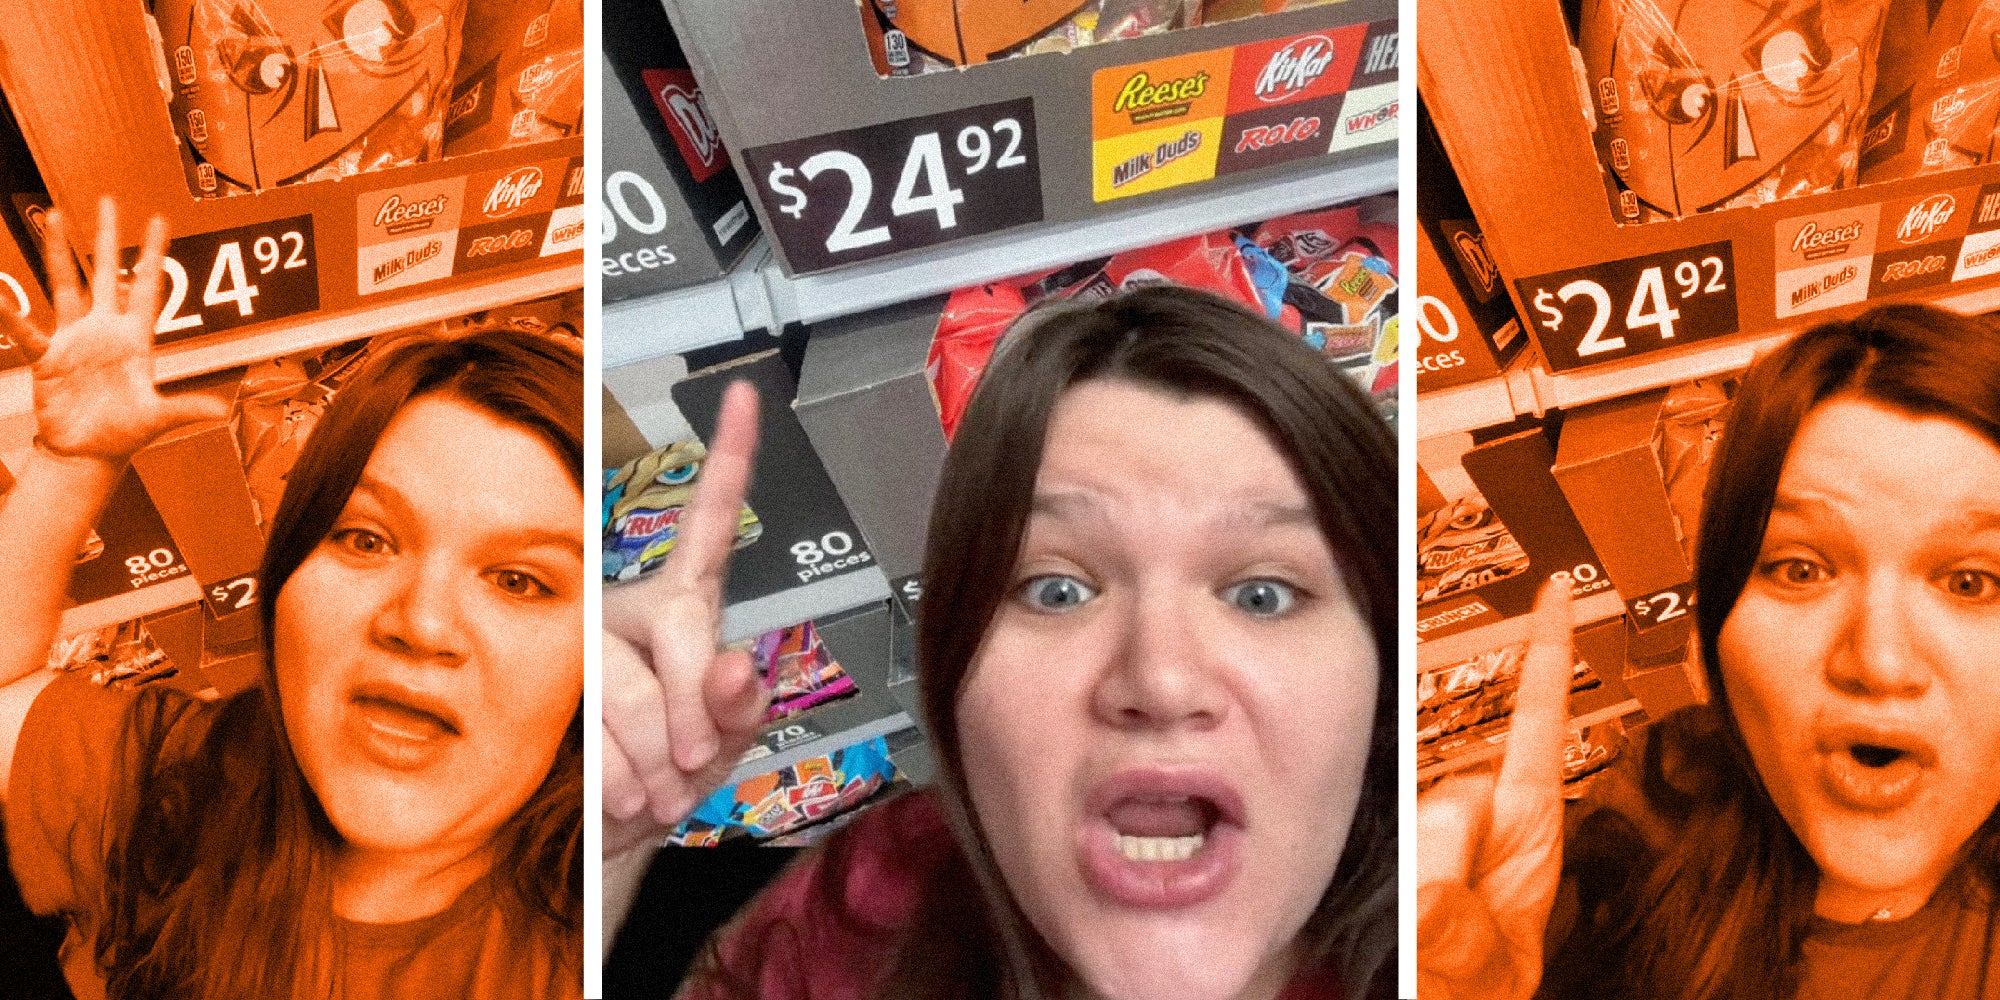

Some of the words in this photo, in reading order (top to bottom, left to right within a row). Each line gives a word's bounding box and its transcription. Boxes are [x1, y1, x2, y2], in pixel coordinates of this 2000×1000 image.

[887, 34, 904, 50] 130
[1255, 42, 1334, 95] KitKat
[1114, 71, 1209, 113] Reese's
[1113, 151, 1152, 188] Milk
[483, 172, 543, 213] KitKat
[374, 194, 448, 227] Reese's
[1897, 199, 1954, 239] KitKat
[1792, 221, 1864, 252] Reese's
[374, 256, 403, 284] Milk
[1791, 282, 1820, 309] Milk
[125, 548, 174, 575] 80
[790, 531, 853, 564] 80
[130, 563, 187, 588] pieces
[797, 551, 871, 582] pieces
